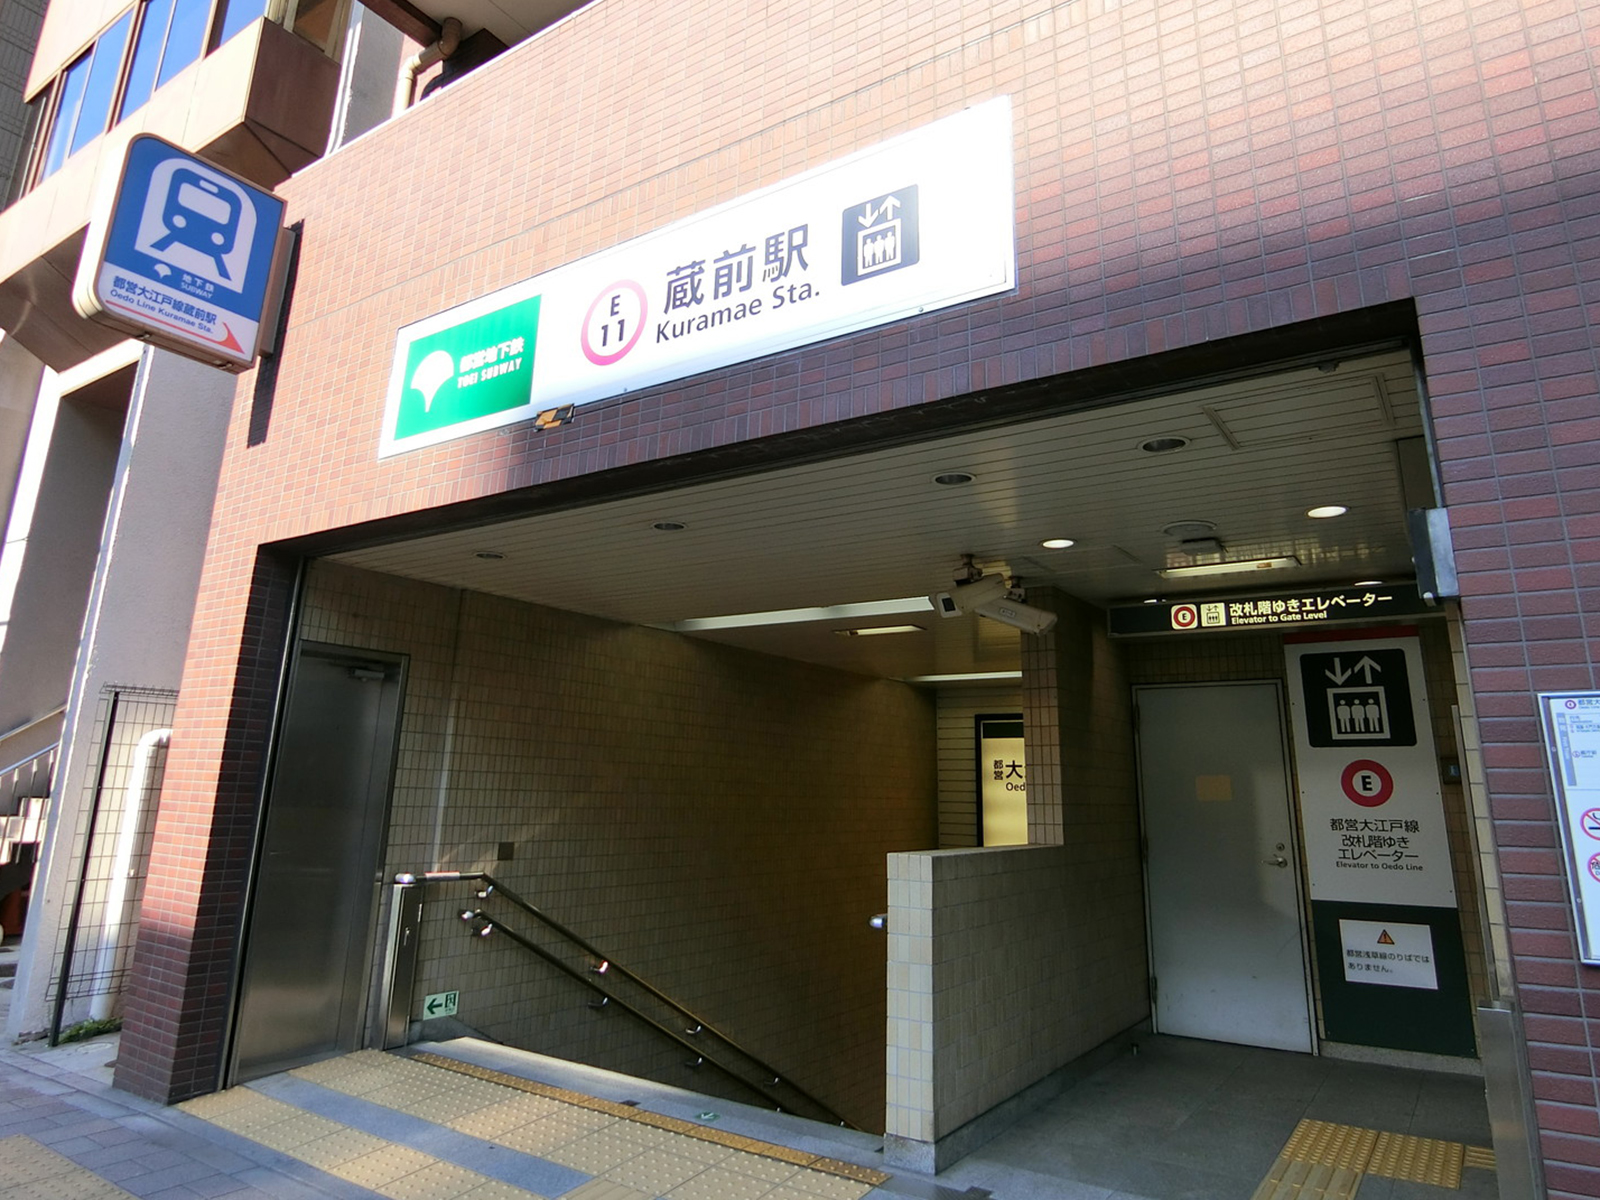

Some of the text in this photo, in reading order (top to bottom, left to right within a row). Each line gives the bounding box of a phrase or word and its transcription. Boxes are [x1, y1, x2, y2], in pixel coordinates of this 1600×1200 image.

[663, 223, 809, 315] 蔵前駅
[181, 282, 214, 299] SUBWAY
[182, 273, 214, 292] 地下鉄
[113, 275, 217, 325] 都営大江戸線蔵前駅
[610, 294, 621, 317] E
[110, 289, 213, 334] Oedo Line Kuramae Sta.
[656, 282, 820, 344] Kuramae Sta.
[601, 319, 625, 347] 11
[457, 357, 523, 389] TOEI SUBWAY
[1229, 592, 1393, 617] 改札階ゆきエレベーター
[1182, 612, 1188, 621] E
[1231, 615, 1267, 625] Elevator
[1280, 612, 1301, 621] Gate
[1303, 611, 1327, 620] Level
[993, 760, 1004, 780] 都営
[1361, 775, 1373, 791] E
[1330, 818, 1420, 833] 都営大江戸線
[1341, 834, 1410, 849] 改札階ゆき
[1338, 848, 1419, 862] エレベーター
[1336, 861, 1368, 869] Elevator
[1381, 862, 1404, 871] Oedo
[1406, 863, 1423, 871] Line
[1346, 949, 1430, 963] 都営浅草線のりばでは
[1348, 962, 1393, 973] ありません。
